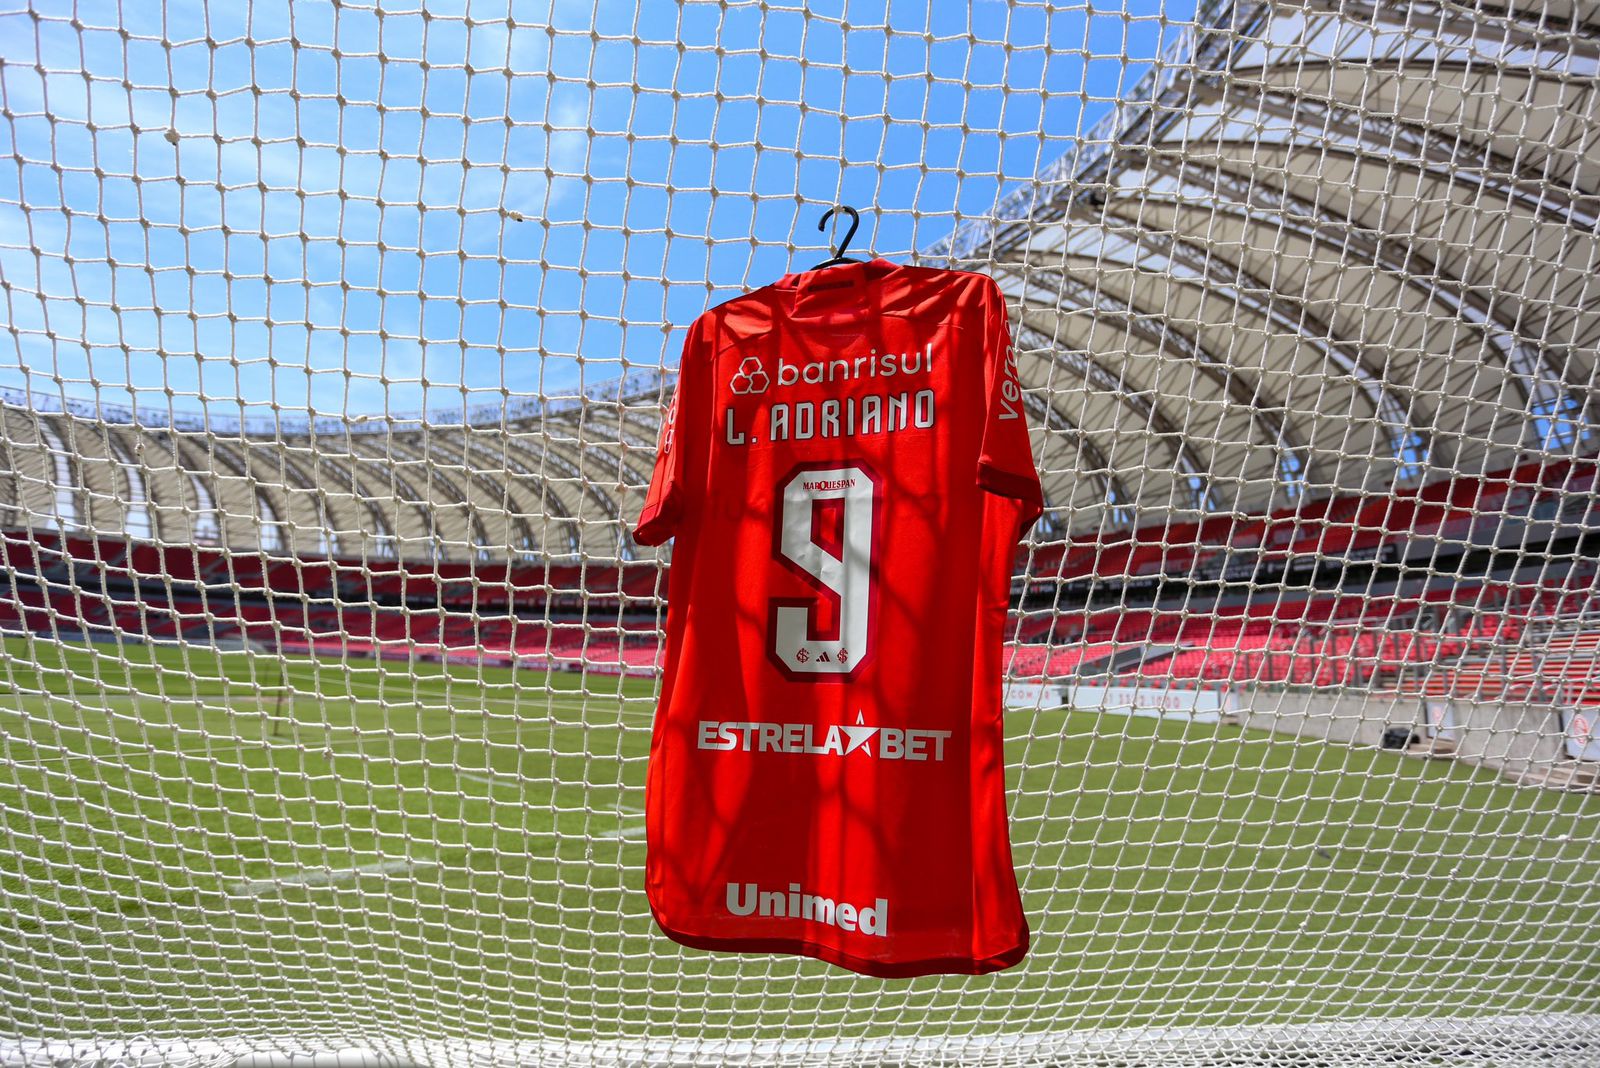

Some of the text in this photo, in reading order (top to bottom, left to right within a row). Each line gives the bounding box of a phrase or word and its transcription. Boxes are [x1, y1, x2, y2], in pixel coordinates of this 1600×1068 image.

[777, 343, 934, 386] banrisul
[726, 388, 936, 446] L. ADRIANO
[803, 479, 856, 491] MARQUESPAN
[776, 467, 874, 673] 9
[697, 720, 953, 761] ESTRELA BET
[726, 882, 888, 937] Unimed
